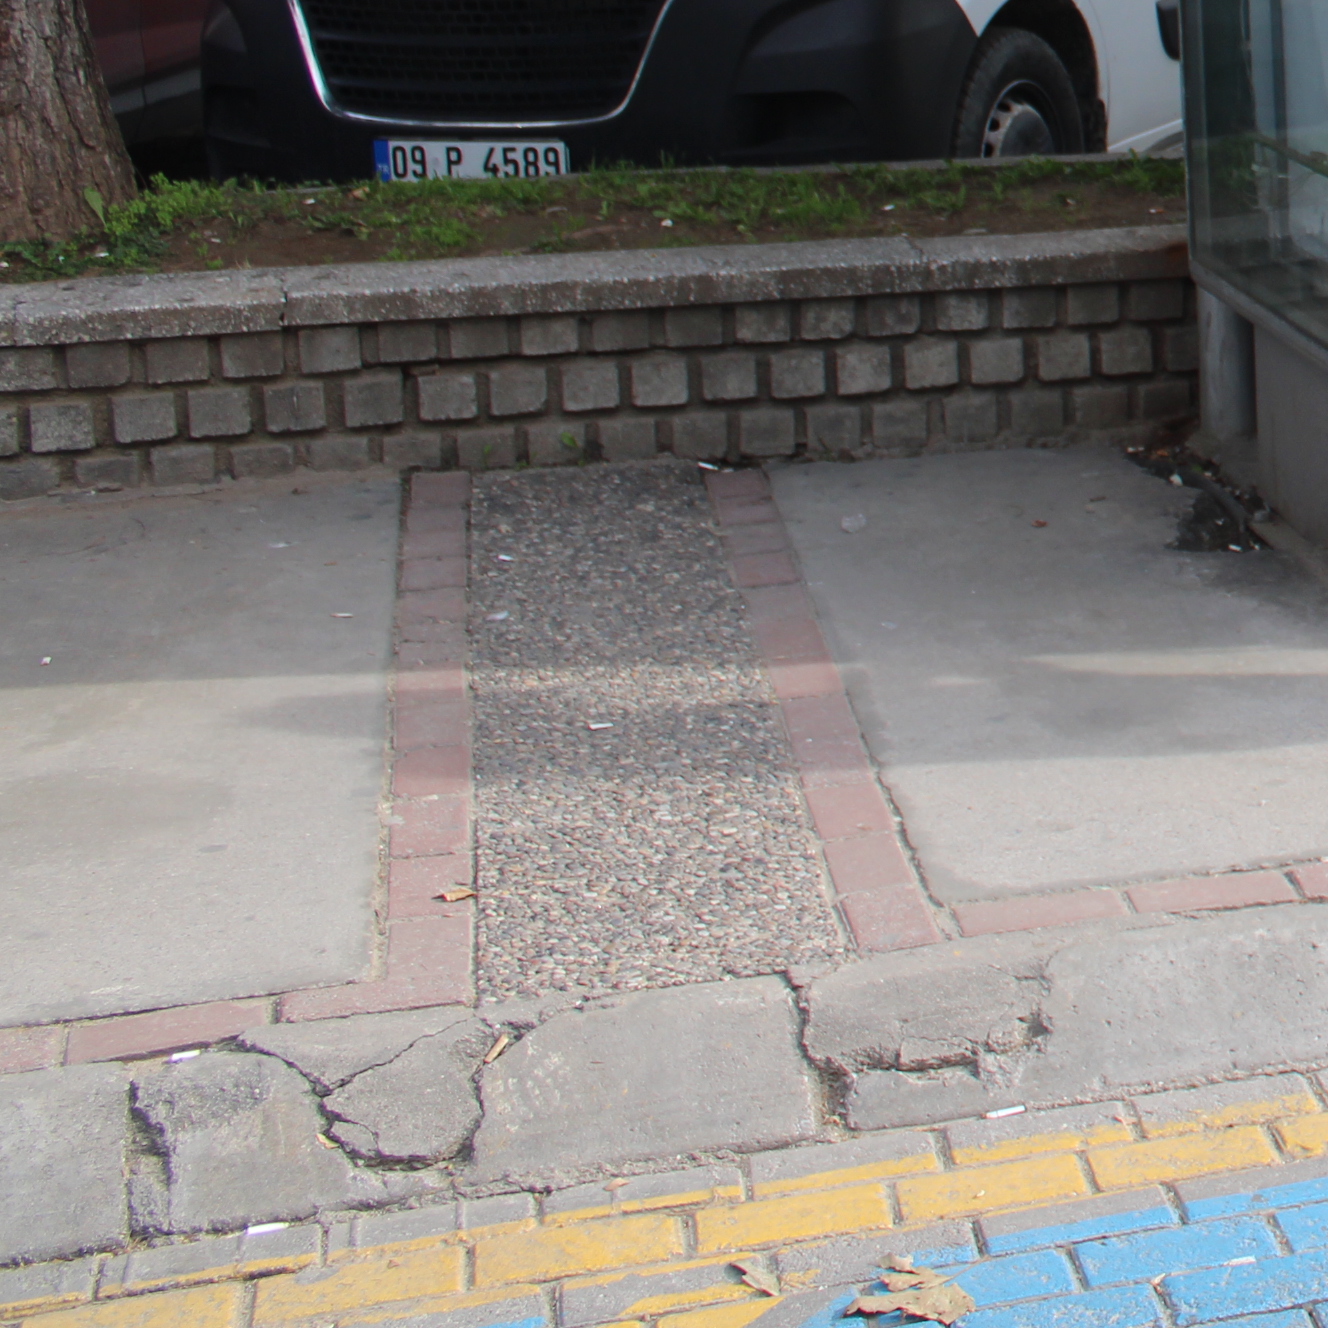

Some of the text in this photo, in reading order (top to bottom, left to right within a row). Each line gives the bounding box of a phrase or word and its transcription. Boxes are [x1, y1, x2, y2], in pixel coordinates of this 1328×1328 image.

[391, 145, 561, 179] 09 P 4589
